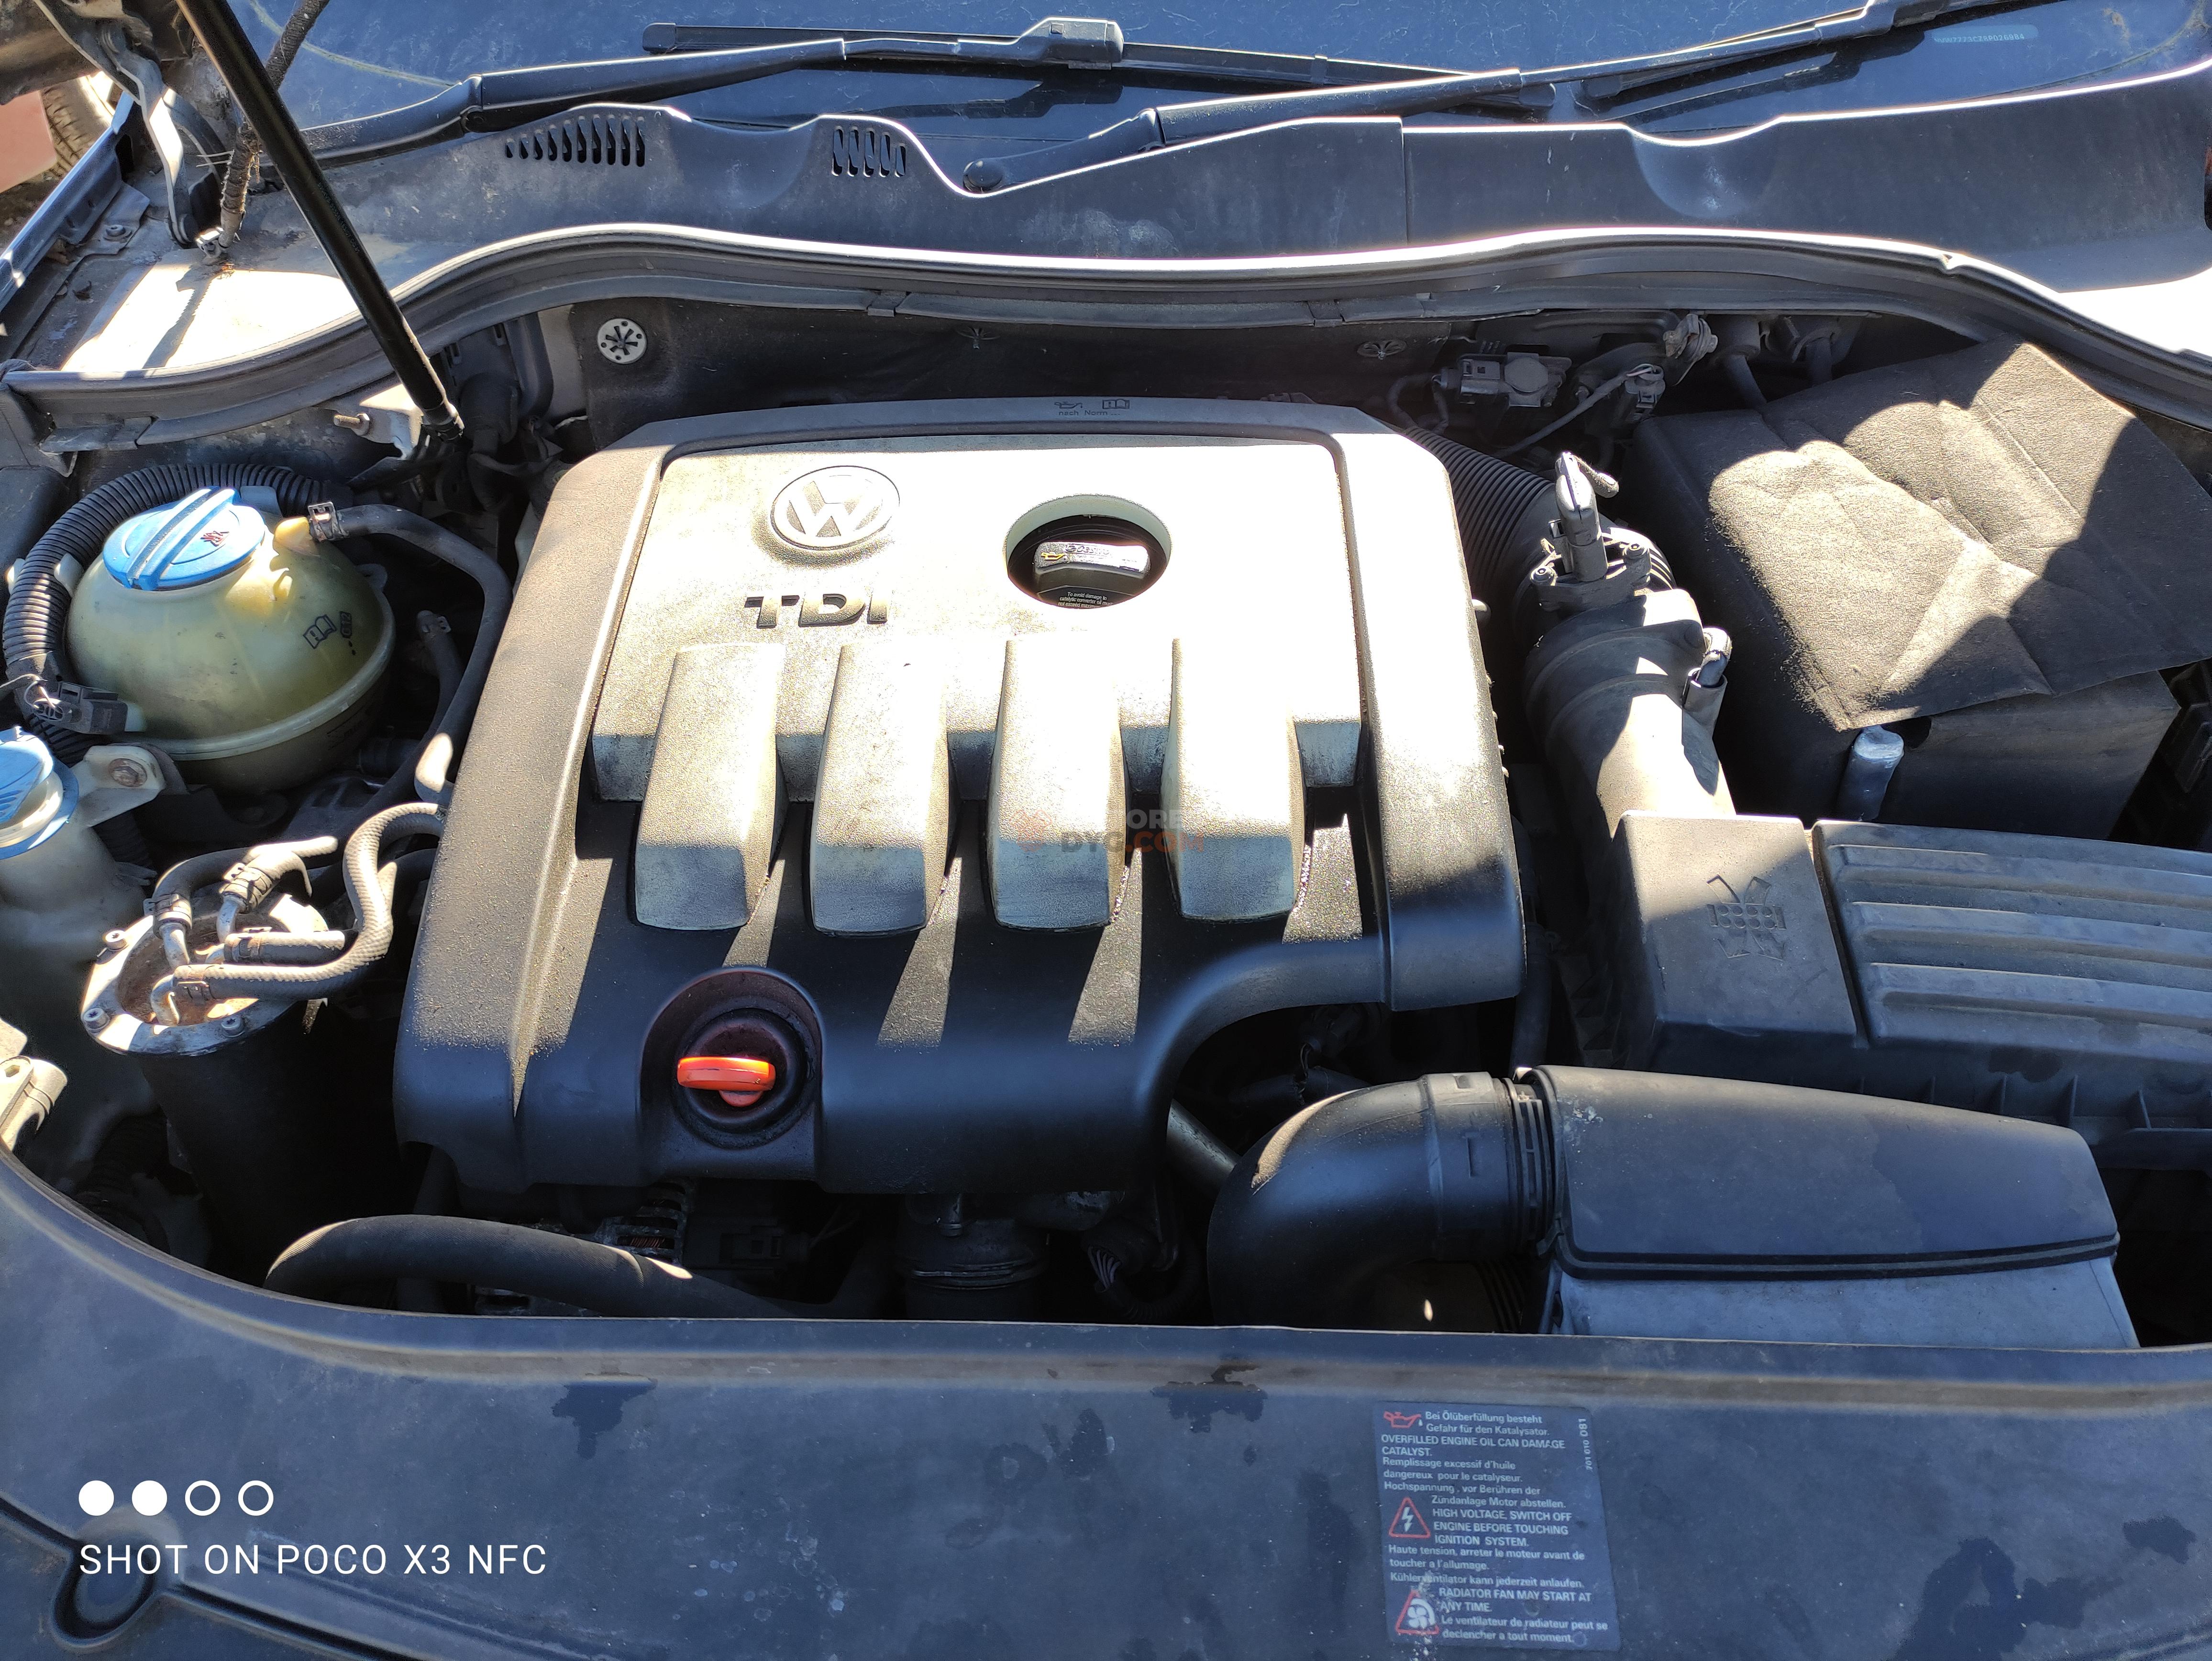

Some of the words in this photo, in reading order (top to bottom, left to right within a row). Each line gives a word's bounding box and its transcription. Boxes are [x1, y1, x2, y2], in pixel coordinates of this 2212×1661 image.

[745, 594, 888, 629] TDI
[1442, 1410, 1504, 1424] Ölüberfüllung
[1507, 1414, 1542, 1423] besteht
[1426, 1424, 1457, 1432] Gefahr
[1460, 1425, 1473, 1433] für
[1495, 1426, 1549, 1436] Katalysator.
[1578, 1418, 1589, 1437] 081
[1382, 1435, 1438, 1444] OVERFILLED
[1441, 1437, 1478, 1445] ENGINE
[1480, 1438, 1496, 1446] OIL
[1498, 1438, 1519, 1447] CAN
[1522, 1439, 1565, 1449] DAMAGE
[1382, 1447, 1432, 1456] CATALYST.
[1383, 1457, 1441, 1468] Remplissage
[1444, 1460, 1482, 1468] excessif
[1484, 1461, 1515, 1470] d'huile
[1384, 1470, 1433, 1480] dangereux
[1461, 1472, 1470, 1480] le
[1472, 1473, 1522, 1483] catalyseur.
[1384, 1481, 1454, 1493] Hochspannung
[1480, 1484, 1522, 1494] Berühren
[1525, 1486, 1540, 1495] der
[1432, 1495, 1486, 1506] Zündanlage
[1489, 1497, 1517, 1506] Motor
[1520, 1498, 1566, 1508] abstellen.
[1433, 1508, 1458, 1517] HIGH
[1510, 1511, 1550, 1520] SWITCH
[1553, 1512, 1571, 1521] OFF
[1434, 1522, 1471, 1531] ENGINE
[1474, 1523, 1512, 1532] BEFORE
[1514, 1524, 1569, 1535] TOUCHING
[1435, 1535, 1480, 1544] IGNITION
[1485, 1537, 1529, 1546] SYSTEM.
[1389, 1544, 1417, 1553] Haute
[1460, 1549, 1493, 1557] arreter
[1495, 1548, 1504, 1557] le
[1507, 1550, 1540, 1558] moteur
[1572, 1550, 1584, 1560] de
[1390, 1559, 1427, 1567] toucher
[1470, 1575, 1493, 1584] kann
[1495, 1576, 1537, 1586] jederzeit
[1540, 1578, 1584, 1588] anlaufen.
[1439, 1587, 1491, 1598] RADIATOR
[1494, 1590, 1514, 1599] FAN
[1517, 1590, 1540, 1599] MAY
[1543, 1591, 1576, 1601] START
[1579, 1592, 1592, 1602] AT
[1440, 1602, 1462, 1610] ANY
[1442, 1615, 1453, 1624] Le
[1456, 1616, 1507, 1626] ventilateur
[1510, 1617, 1522, 1626] de
[1525, 1618, 1569, 1628] radiateur
[1571, 1621, 1593, 1630] peut
[1442, 1629, 1496, 1639] declencher
[1508, 1632, 1527, 1640] tout
[1531, 1634, 1574, 1642] moment.
